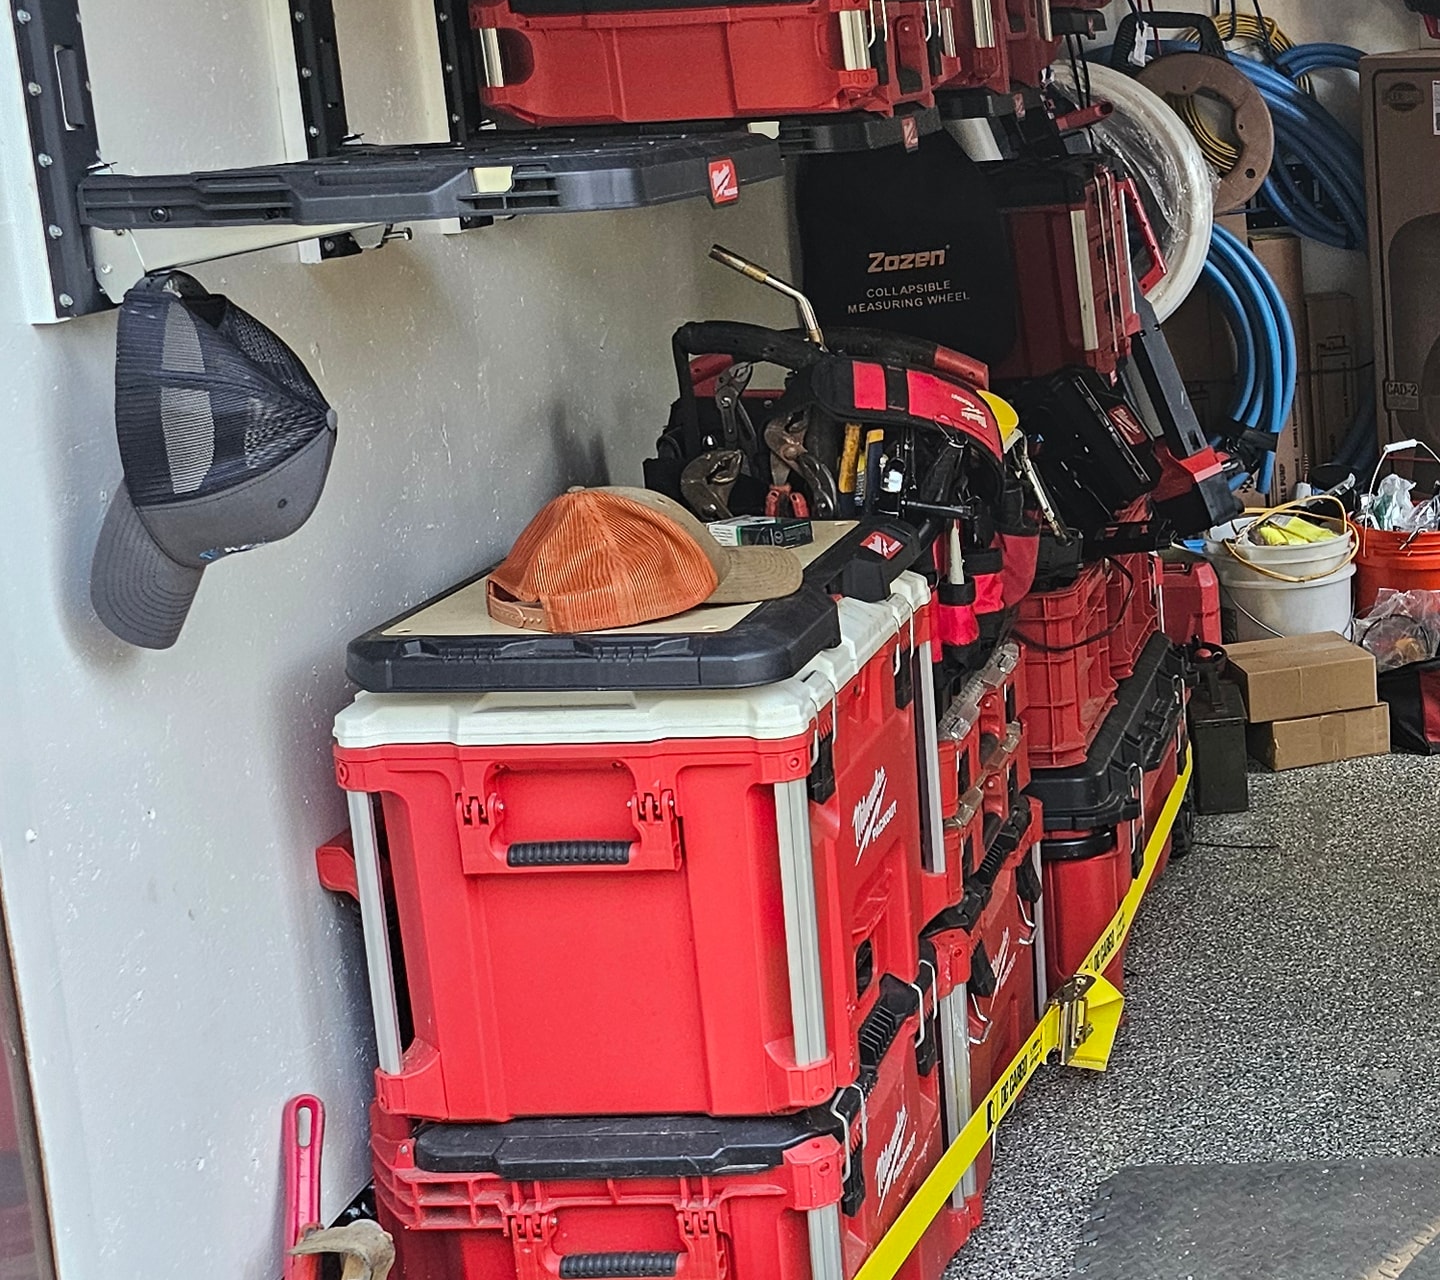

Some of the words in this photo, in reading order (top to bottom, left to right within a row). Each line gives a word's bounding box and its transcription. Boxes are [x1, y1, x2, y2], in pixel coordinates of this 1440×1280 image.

[867, 249, 946, 274] Zozen
[866, 280, 952, 299] COLLAPSIBLE
[847, 297, 924, 315] MEASURING
[926, 291, 971, 306] WHEEL
